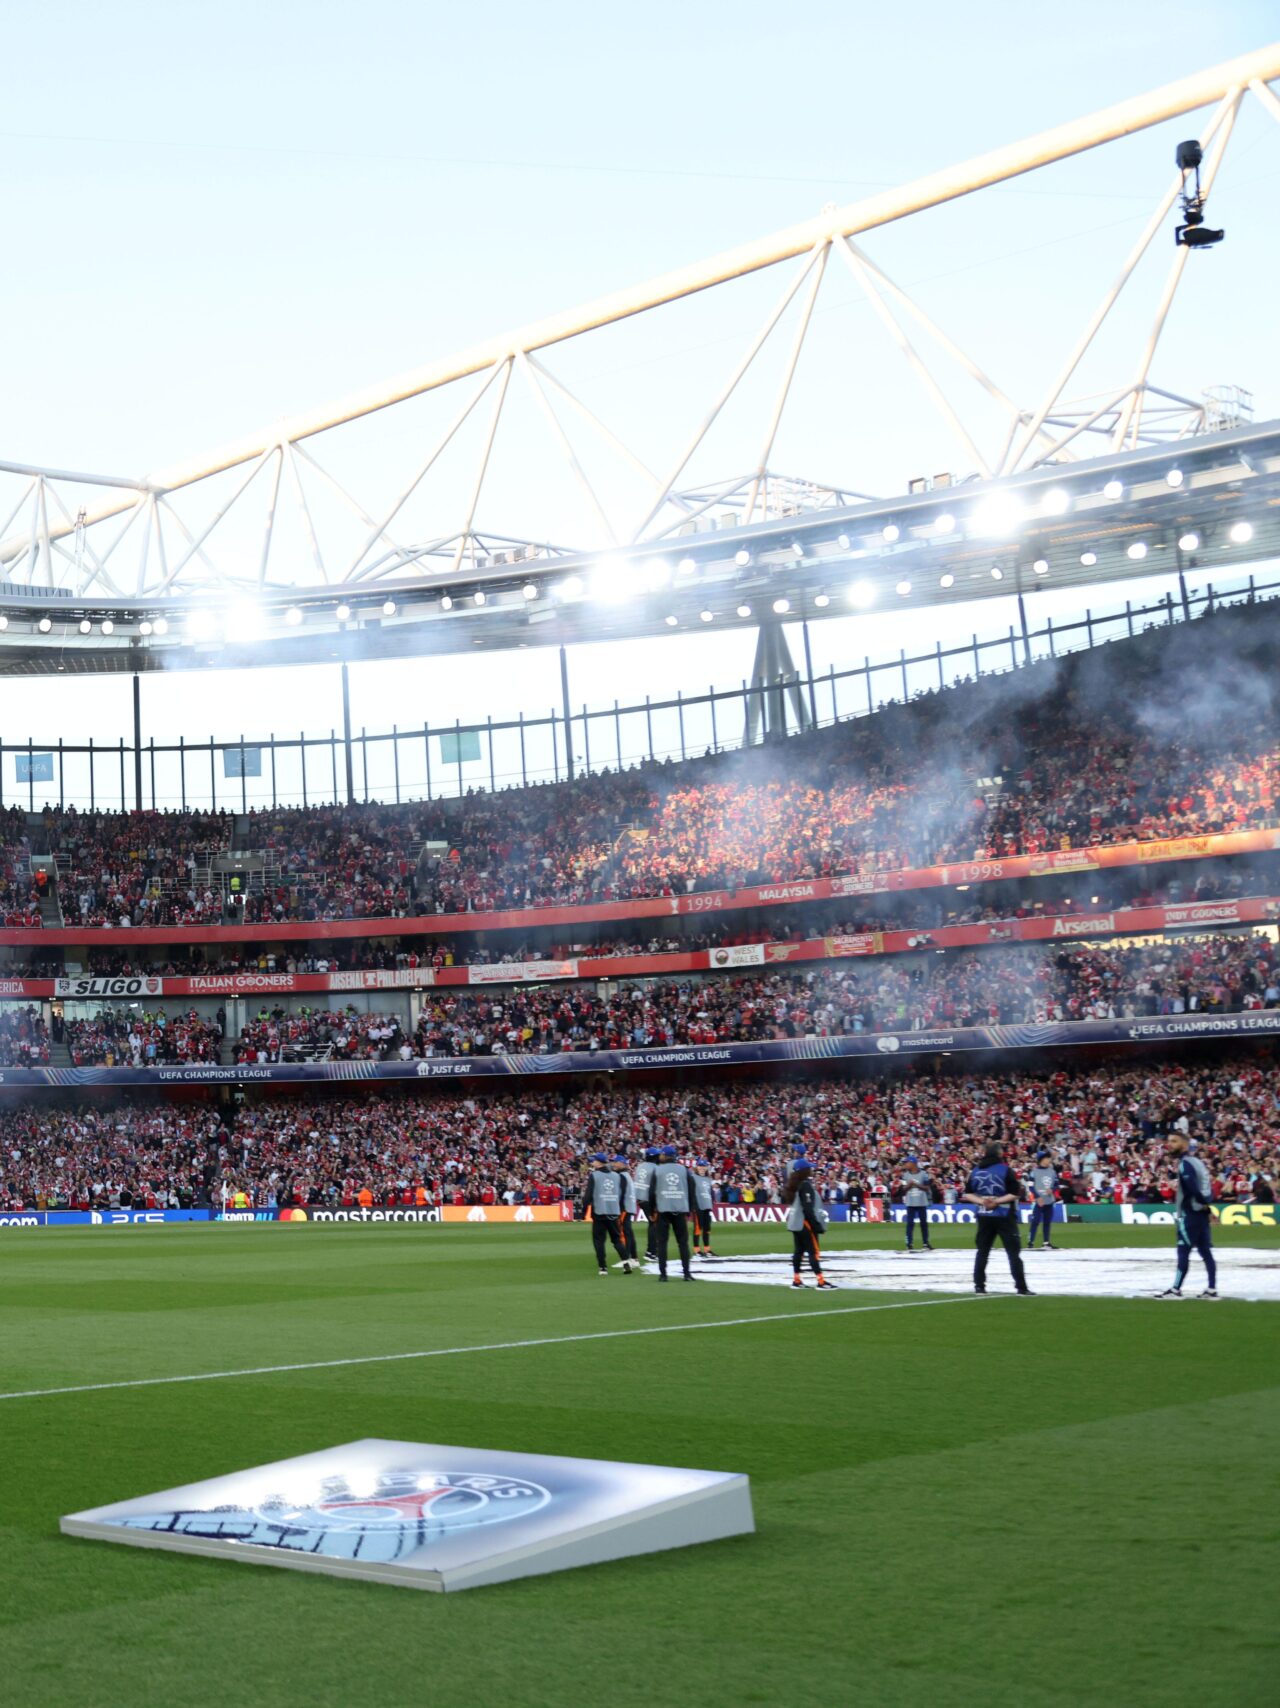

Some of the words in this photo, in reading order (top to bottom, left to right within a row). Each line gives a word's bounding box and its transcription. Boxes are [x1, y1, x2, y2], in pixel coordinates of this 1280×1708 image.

[960, 863, 1003, 880] 1998
[759, 885, 815, 900] MALAYSIA
[687, 896, 722, 911] 1994
[1191, 906, 1238, 919] GOONERS
[1052, 914, 1115, 935] Arsenal
[734, 946, 756, 955] WEST
[732, 955, 760, 965] WALES
[190, 976, 233, 988] ITALIAN
[236, 975, 294, 987] GOONERS
[329, 972, 365, 989] ARSENAL
[376, 969, 435, 988] PHILADELPHIA
[75, 978, 142, 995] SLIGO
[1166, 1020, 1238, 1033] CHAMPIONS
[902, 1035, 954, 1047] mastercard
[622, 1055, 645, 1064] UEFA
[645, 1052, 696, 1063] CHAMPIONS
[698, 1050, 732, 1060] LEAGUE
[159, 1071, 182, 1079] UEFA
[184, 1070, 236, 1079] CHAMPIONS
[238, 1069, 272, 1078] LEAGUE
[431, 1065, 453, 1075] JUST
[454, 1064, 472, 1073] EAT
[709, 1205, 795, 1222] AIRWAY
